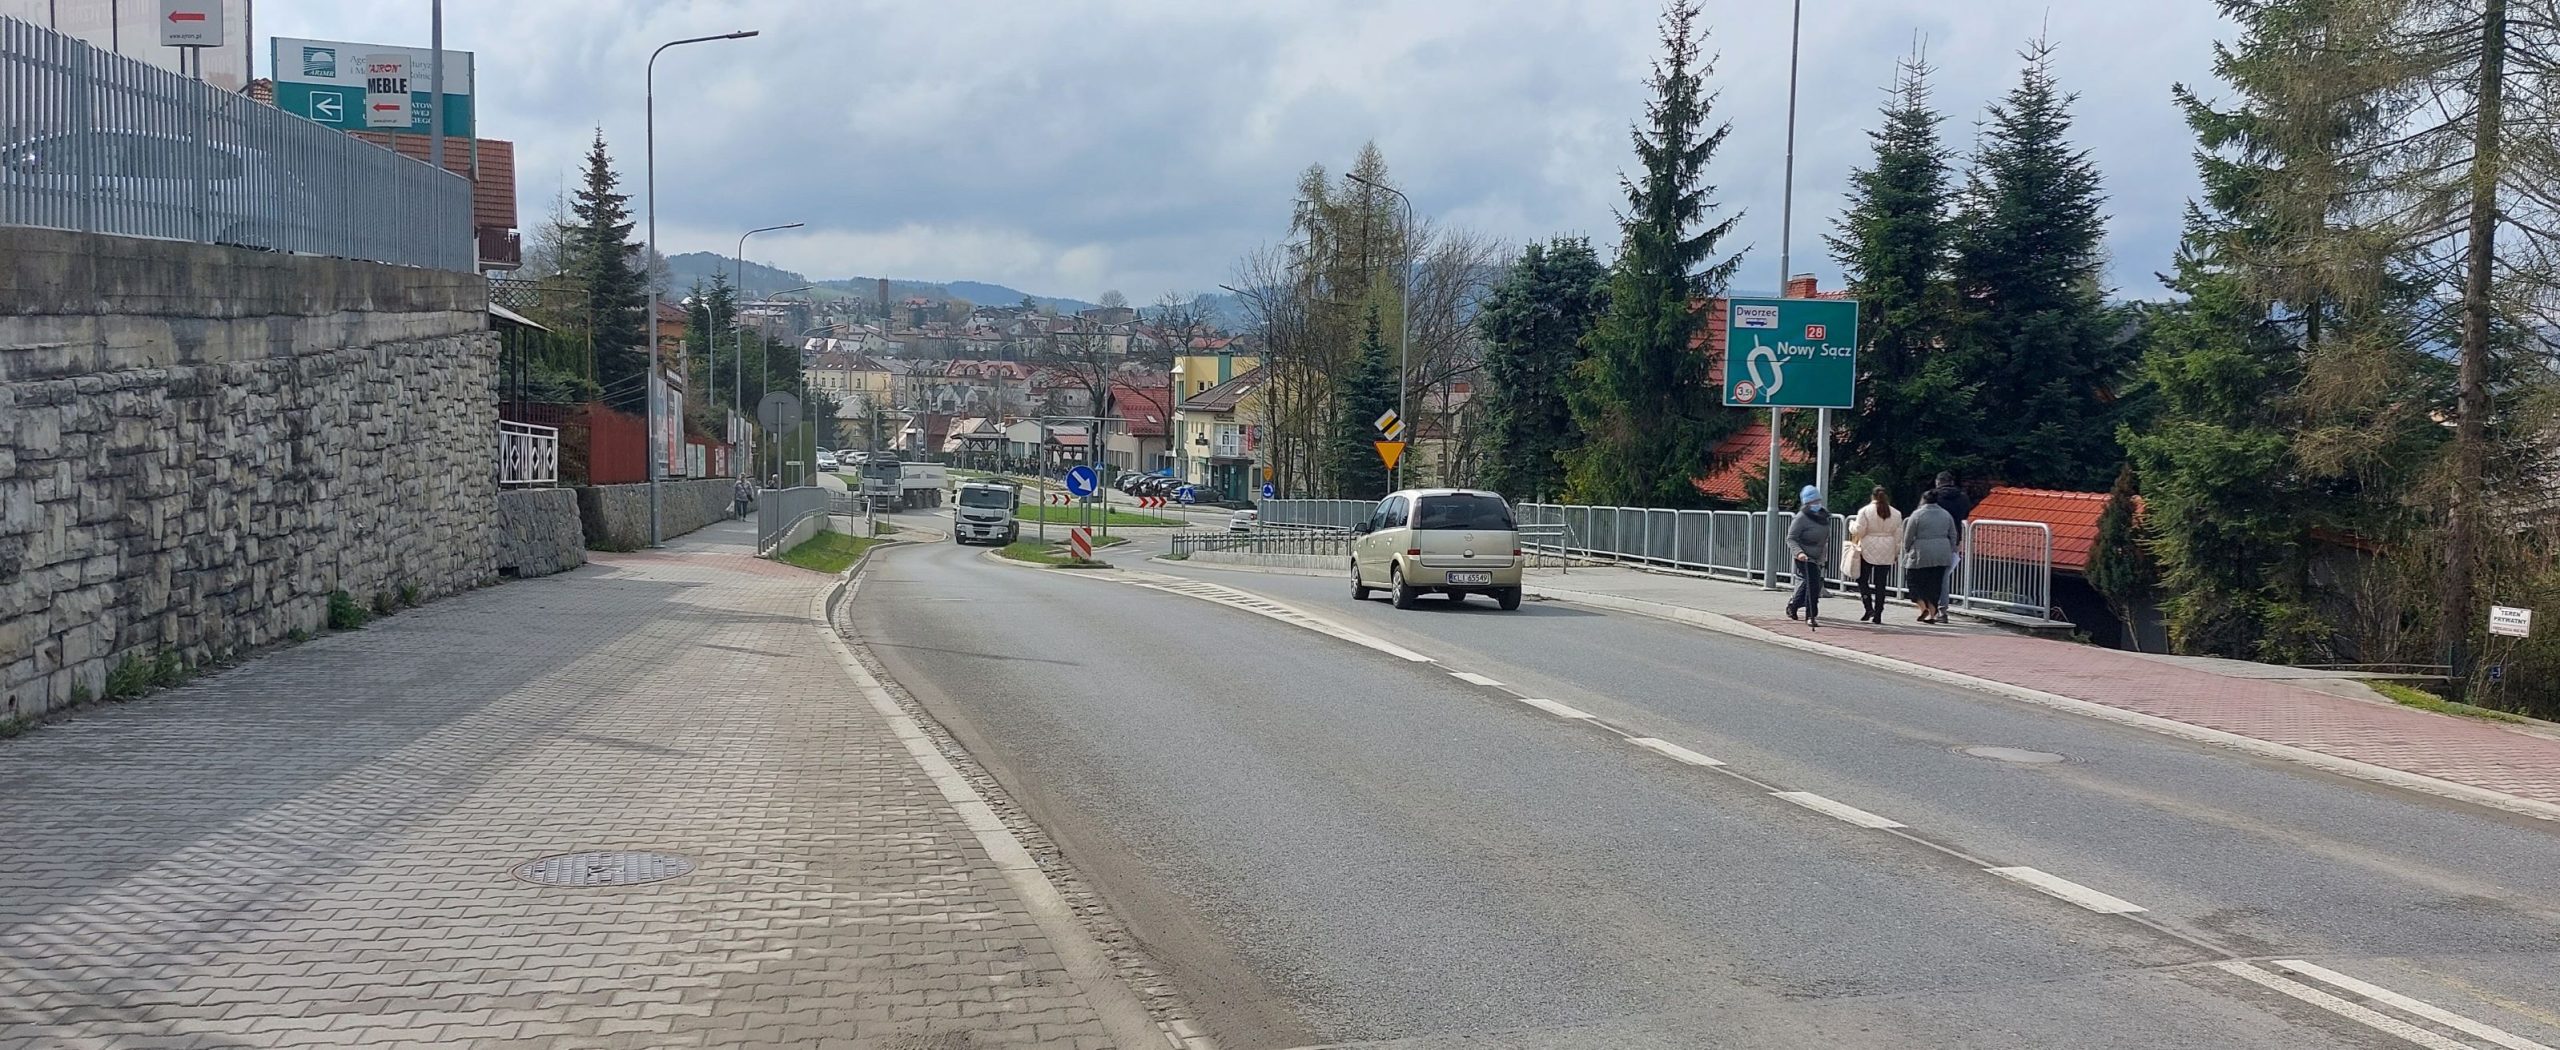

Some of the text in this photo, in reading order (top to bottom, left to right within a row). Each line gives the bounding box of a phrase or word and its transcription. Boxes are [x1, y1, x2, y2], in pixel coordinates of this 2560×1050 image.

[368, 78, 408, 94] MEBLE
[1736, 307, 1777, 318] Dworzec
[1808, 327, 1823, 338] 28
[1777, 342, 1852, 360] Nowy Sącz
[1467, 574, 1488, 582] 65549
[2494, 616, 2527, 624] PRYWATNY
